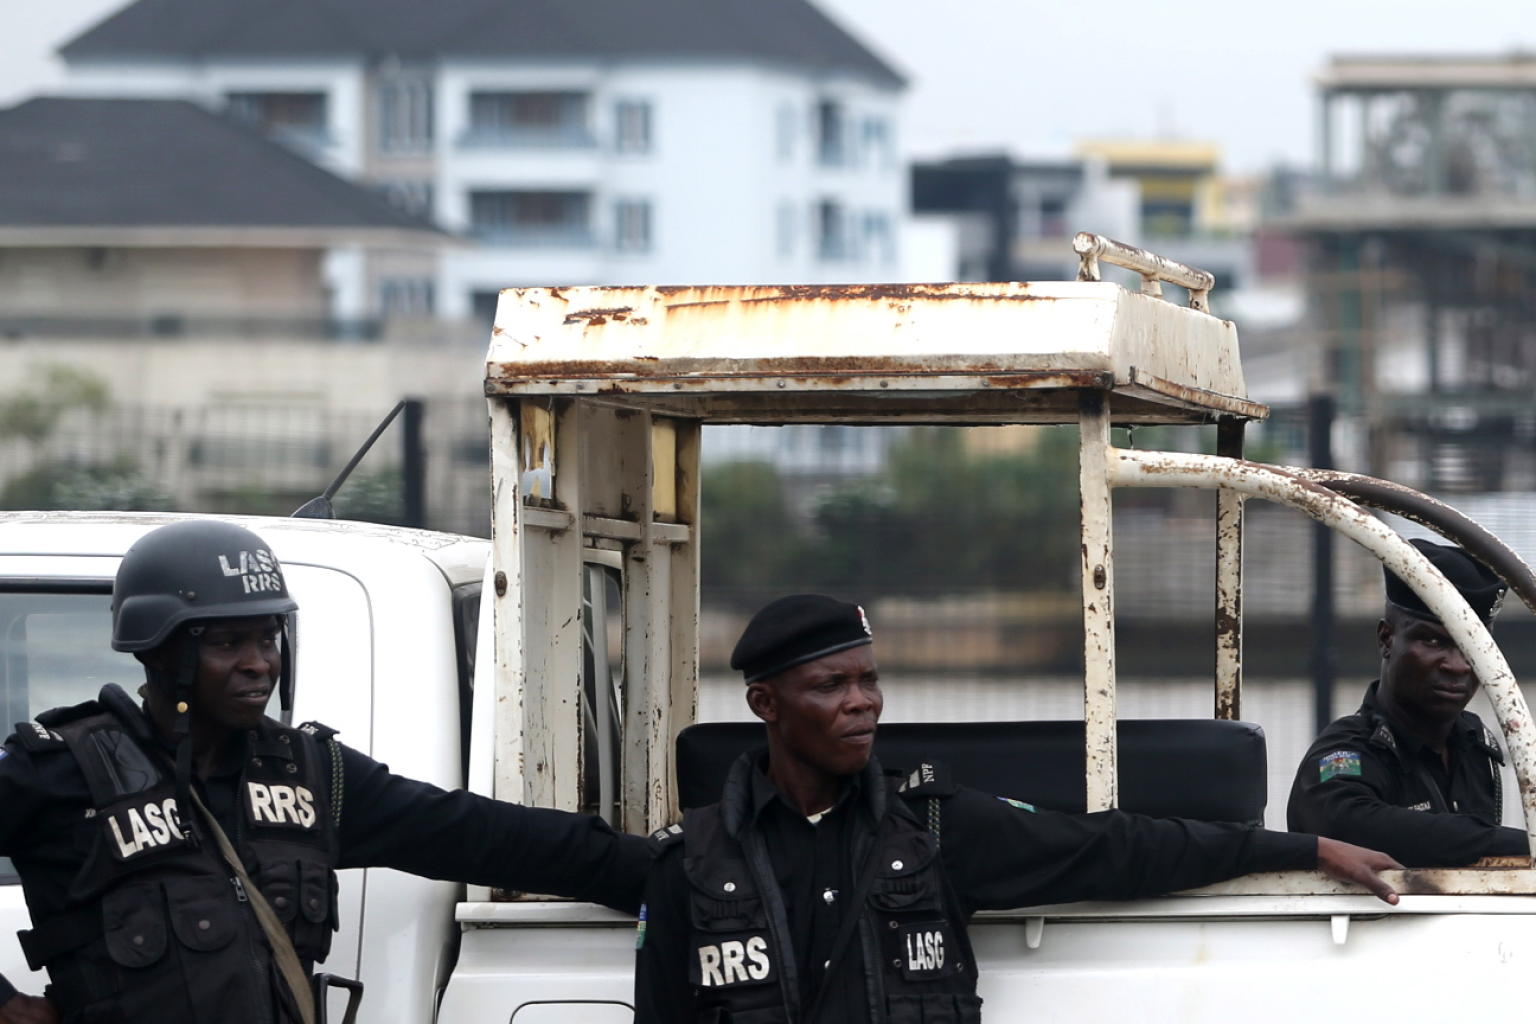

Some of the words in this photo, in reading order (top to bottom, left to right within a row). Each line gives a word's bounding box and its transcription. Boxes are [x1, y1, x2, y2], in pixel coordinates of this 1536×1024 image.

[242, 572, 281, 594] RRS
[921, 763, 935, 783] NPF
[247, 782, 316, 828] RRS
[698, 936, 770, 987] RRS
[906, 931, 945, 970] LASG
